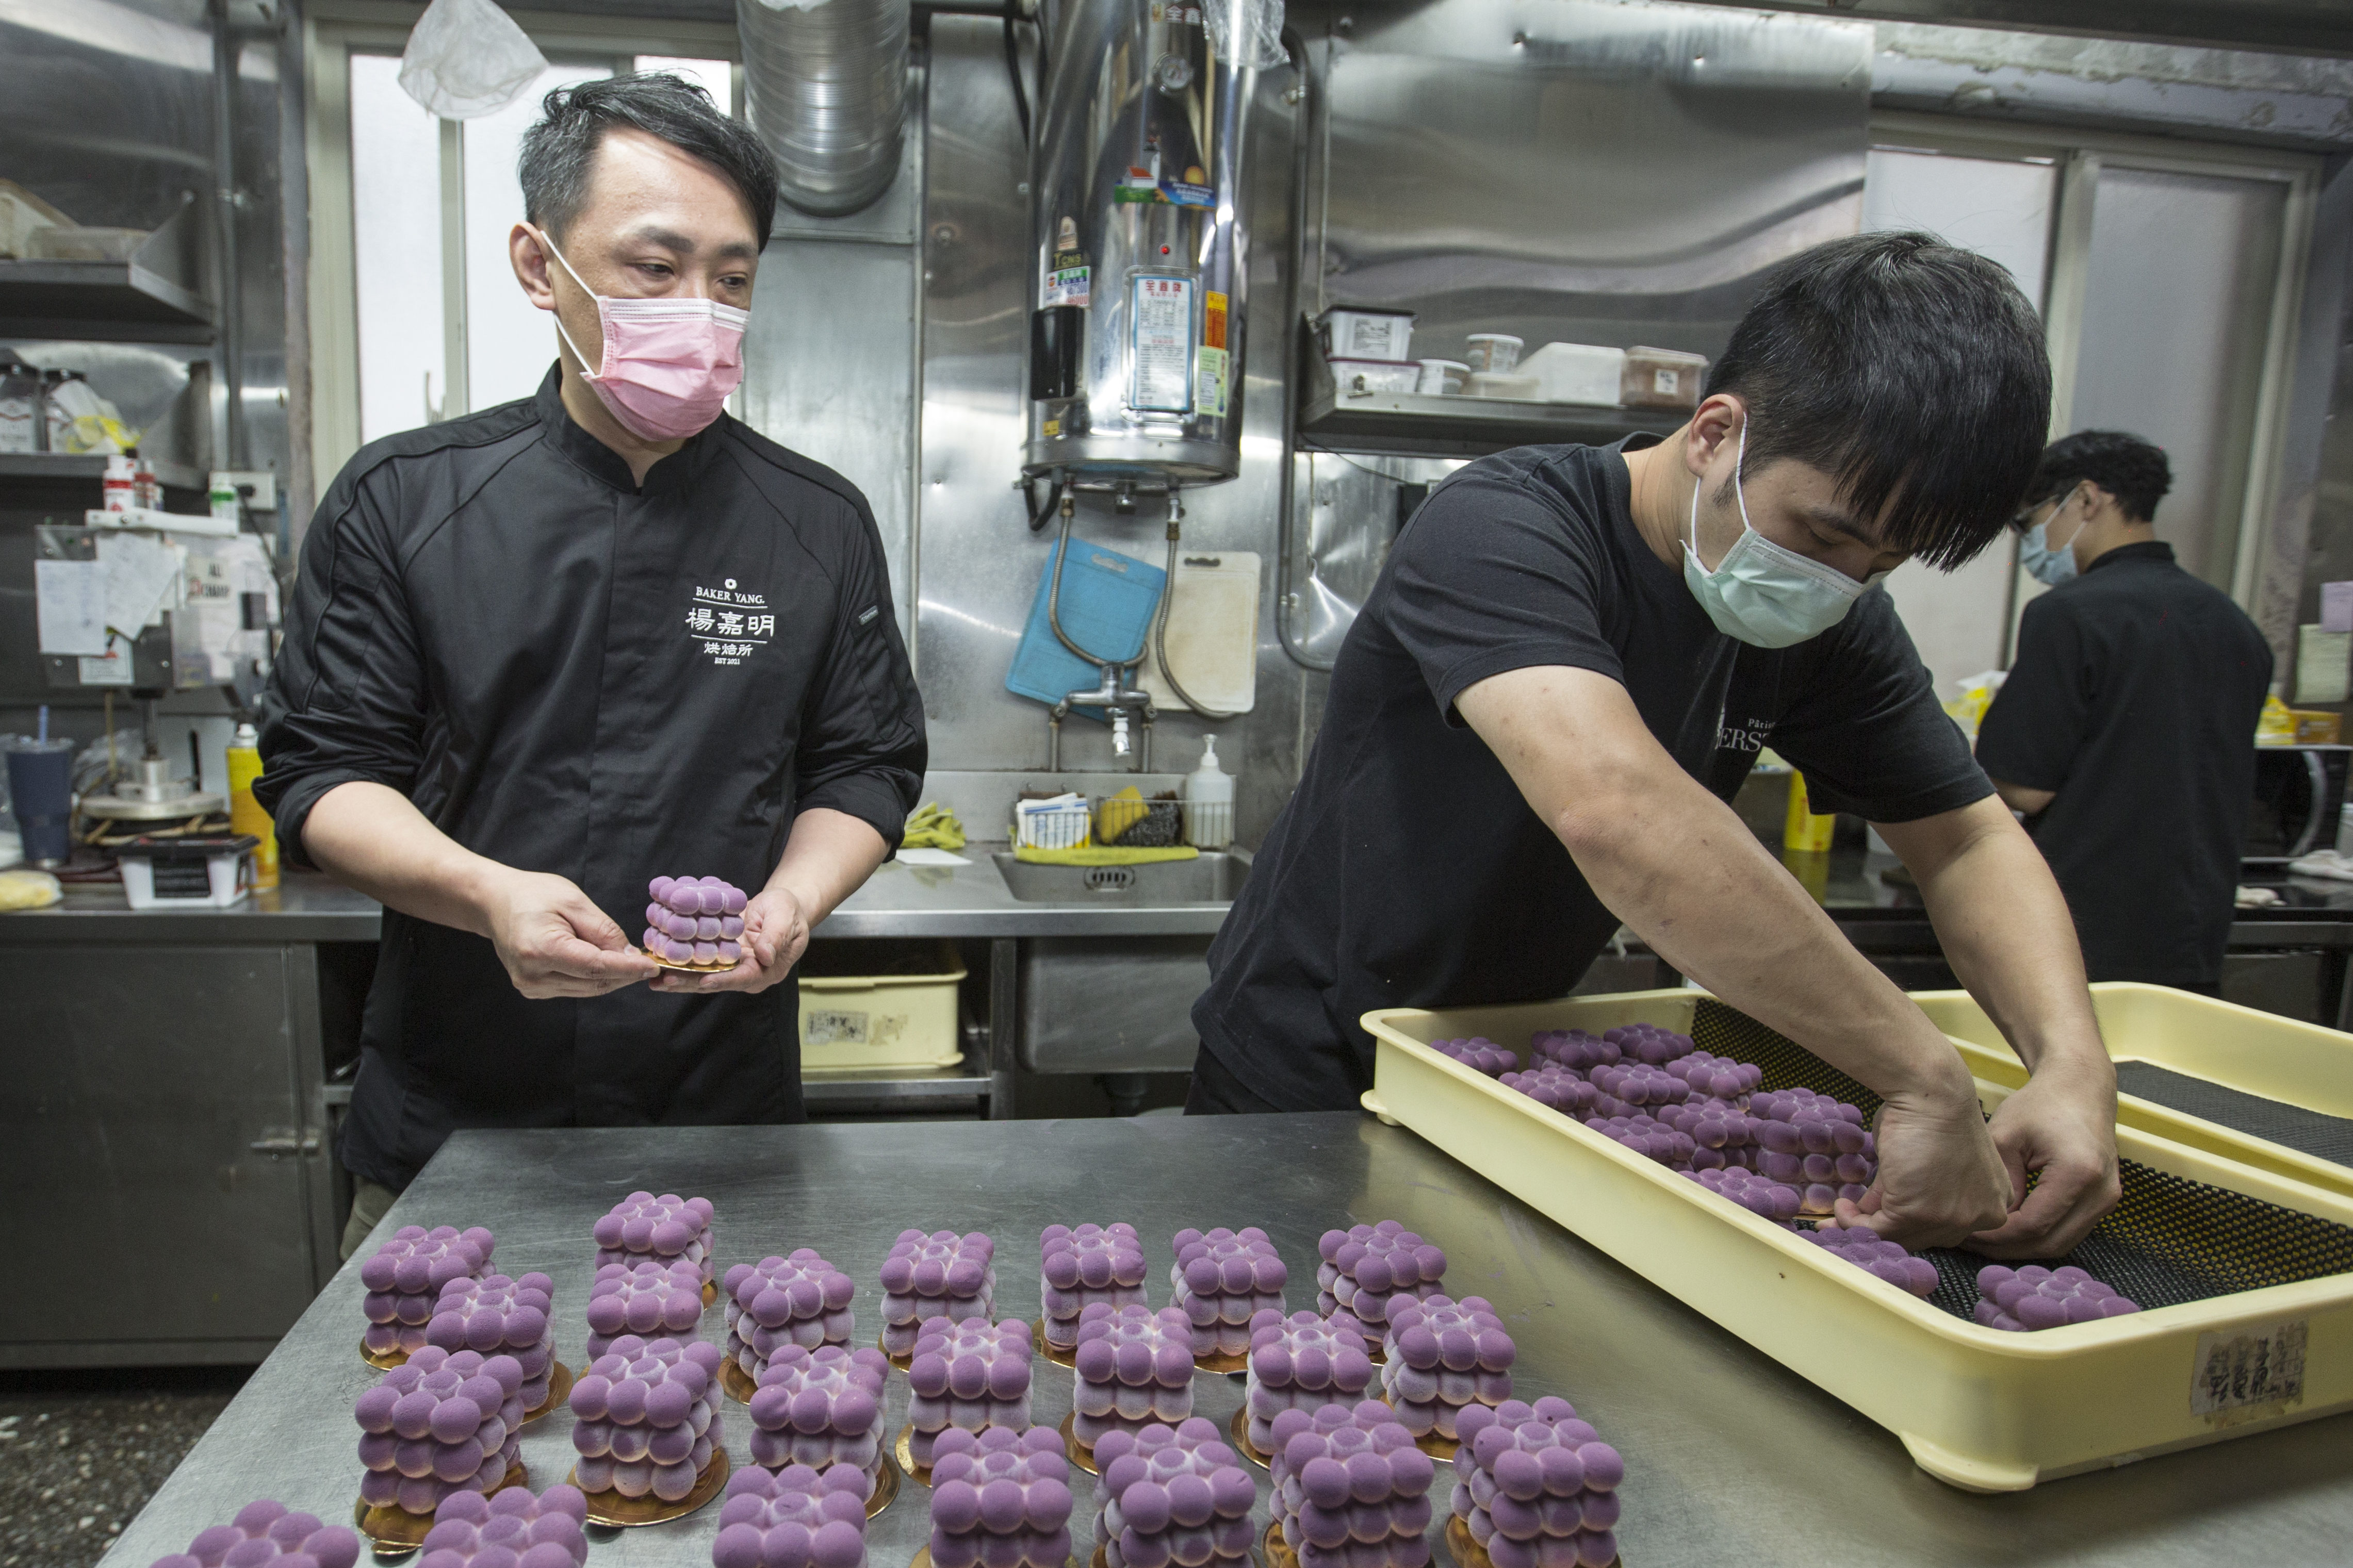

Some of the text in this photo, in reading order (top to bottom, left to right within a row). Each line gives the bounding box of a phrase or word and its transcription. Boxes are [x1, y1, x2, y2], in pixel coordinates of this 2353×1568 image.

[696, 586, 765, 604] BAKER YANG.
[685, 607, 775, 637] 楊嘉明
[704, 641, 753, 656] 烘焙所
[1715, 727, 1770, 752] ERS
